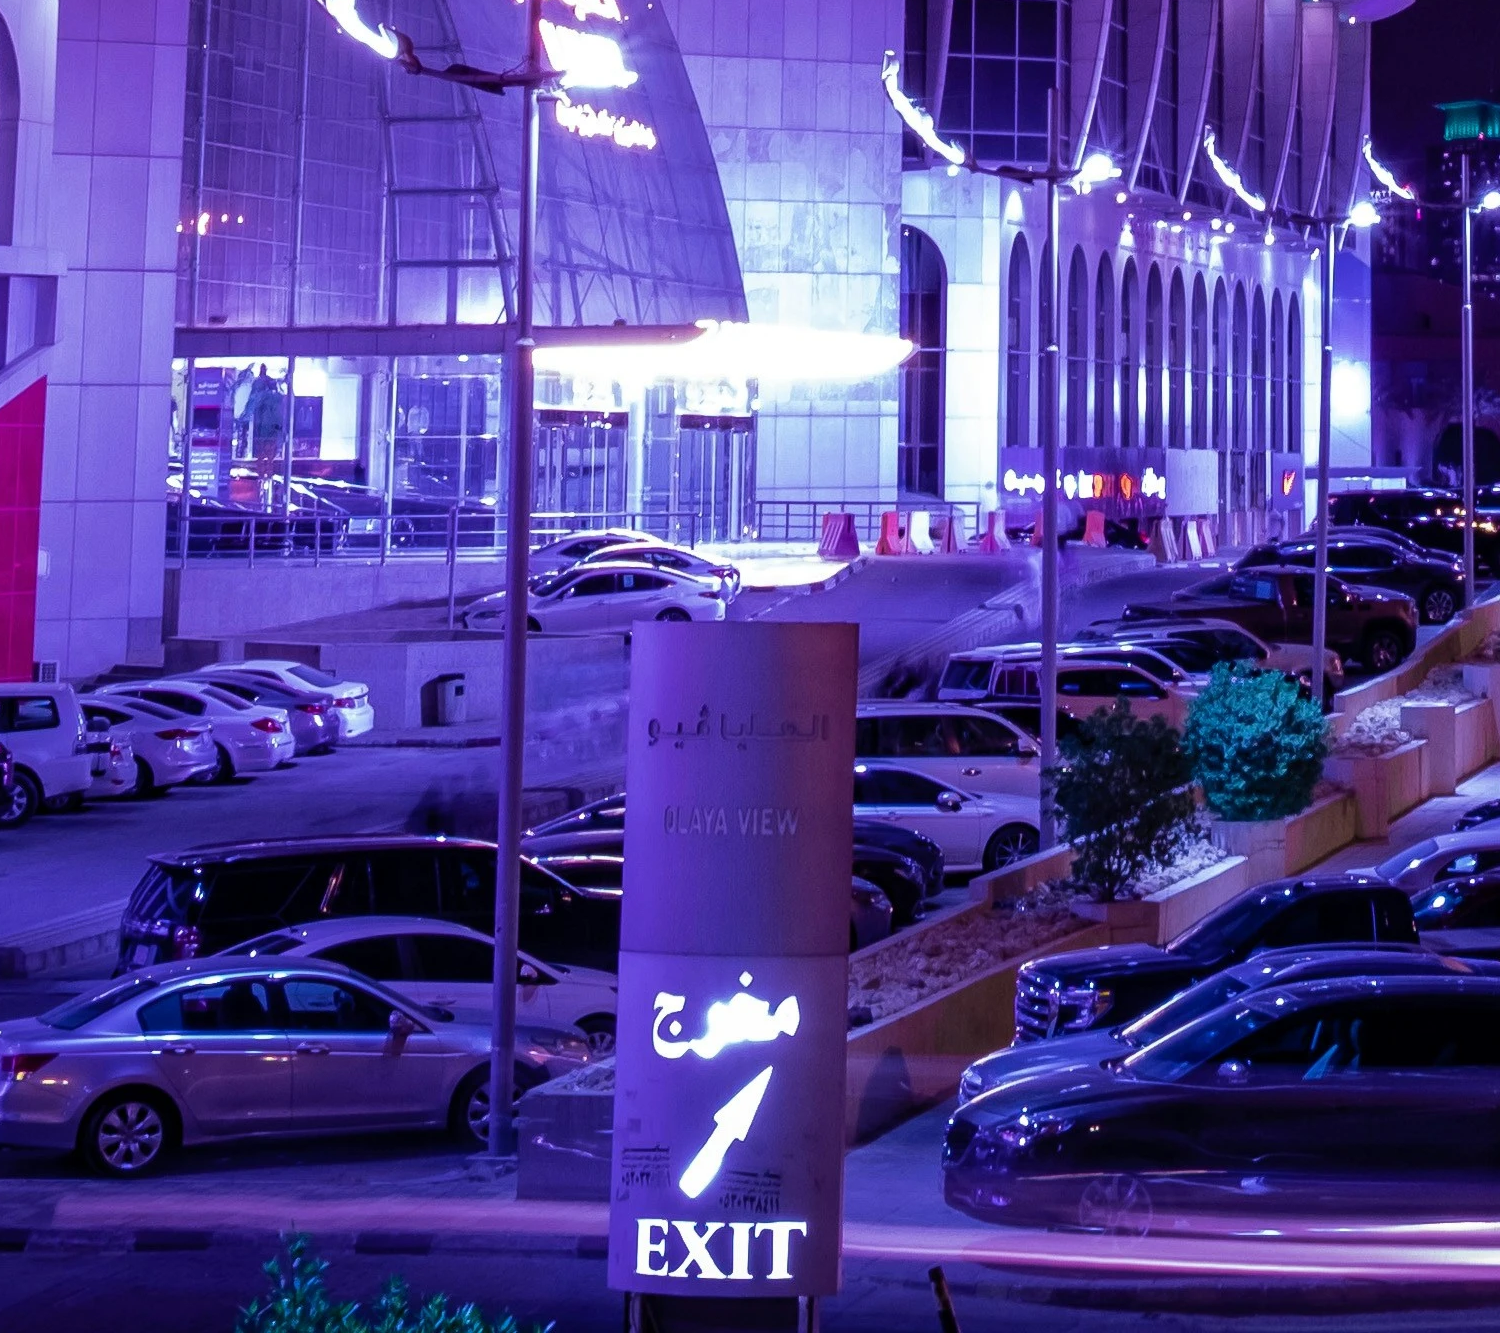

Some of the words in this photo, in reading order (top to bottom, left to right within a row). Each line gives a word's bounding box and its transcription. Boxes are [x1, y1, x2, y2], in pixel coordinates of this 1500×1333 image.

[664, 805, 728, 835] OLAYA
[738, 807, 800, 835] VIEW
[634, 1218, 808, 1282] EXIT
